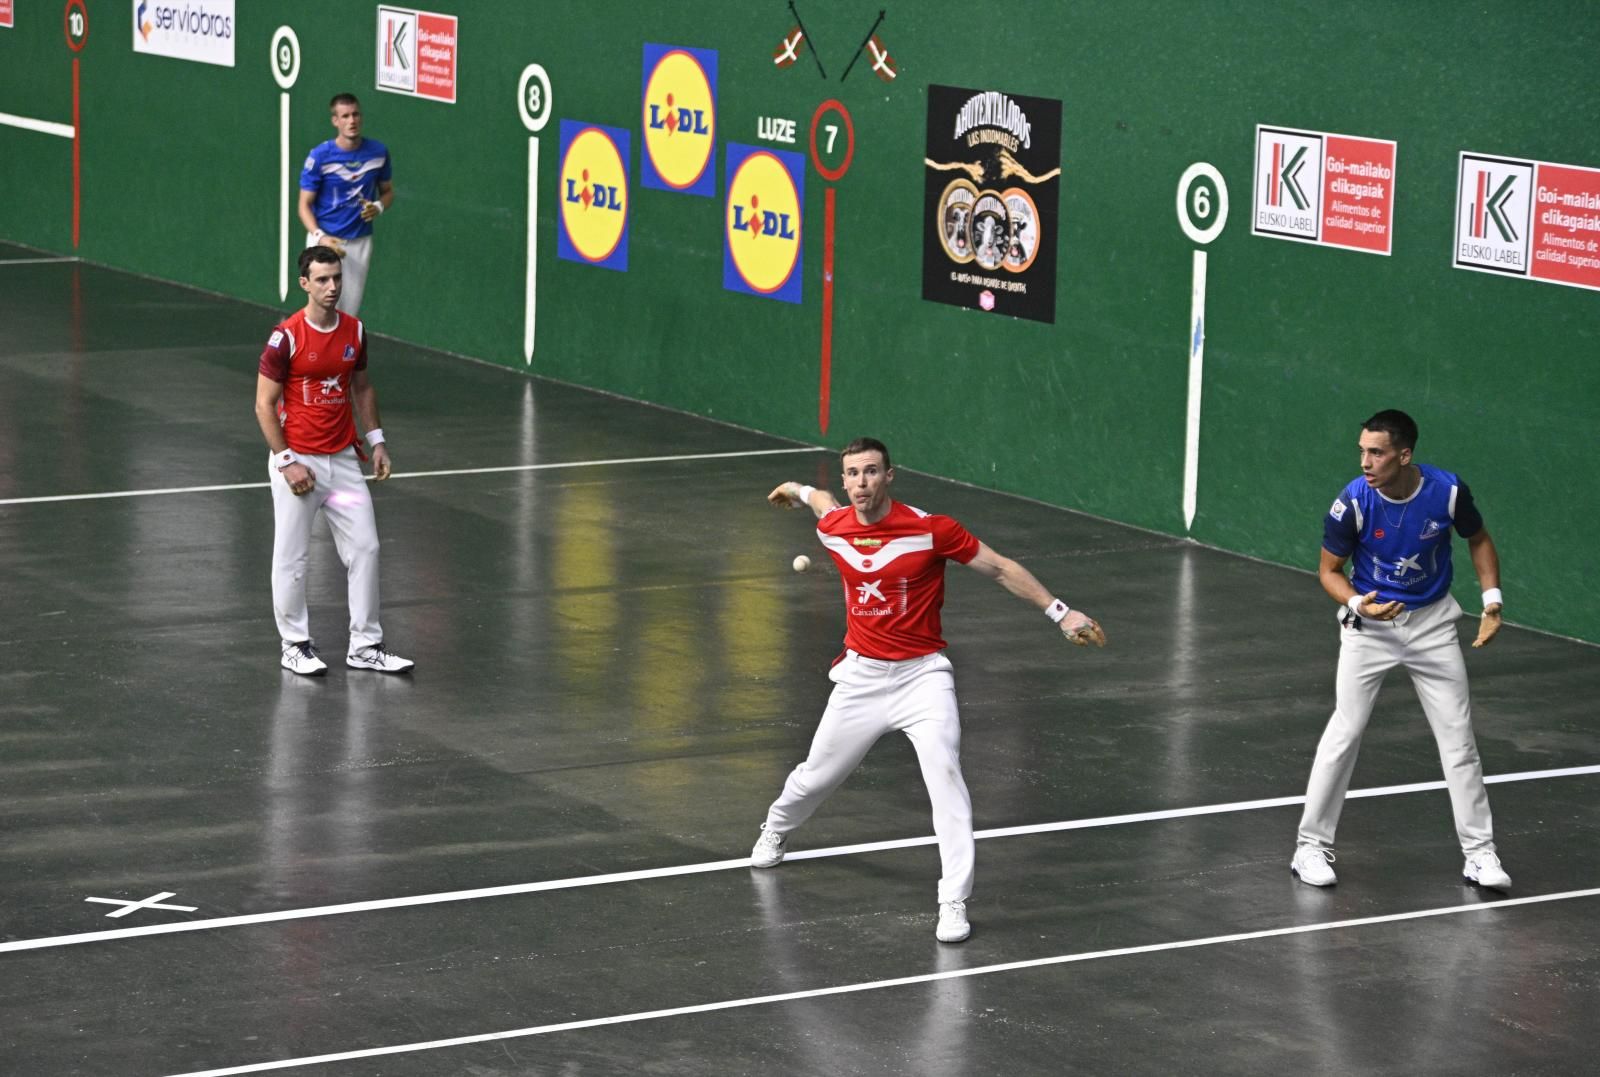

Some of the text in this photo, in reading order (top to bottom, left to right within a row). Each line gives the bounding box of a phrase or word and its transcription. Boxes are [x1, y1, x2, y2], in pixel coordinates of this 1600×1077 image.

[69, 12, 84, 37] 10
[154, 3, 232, 39] serviobras
[278, 44, 291, 71] 9
[528, 84, 541, 113] 8
[757, 116, 797, 144] LUZE
[953, 91, 1031, 149] AHUYENTALOBOS
[824, 125, 839, 154] 7
[967, 128, 1020, 153] LAS INDOMABLES
[1327, 156, 1391, 180] Goi-mailako
[1331, 177, 1385, 200] elikagaiak
[1193, 185, 1211, 219] 6
[1331, 199, 1382, 219] Alimentos de
[1259, 211, 1314, 232] EUSKO LABEL
[1325, 214, 1387, 235] calidad superior
[1541, 208, 1600, 232] elikagaiak
[1542, 231, 1599, 253] Alimentos de
[1461, 243, 1523, 266] EUSKO LABEL
[1535, 247, 1567, 263] calidad
[851, 605, 894, 617] CaixaBank
